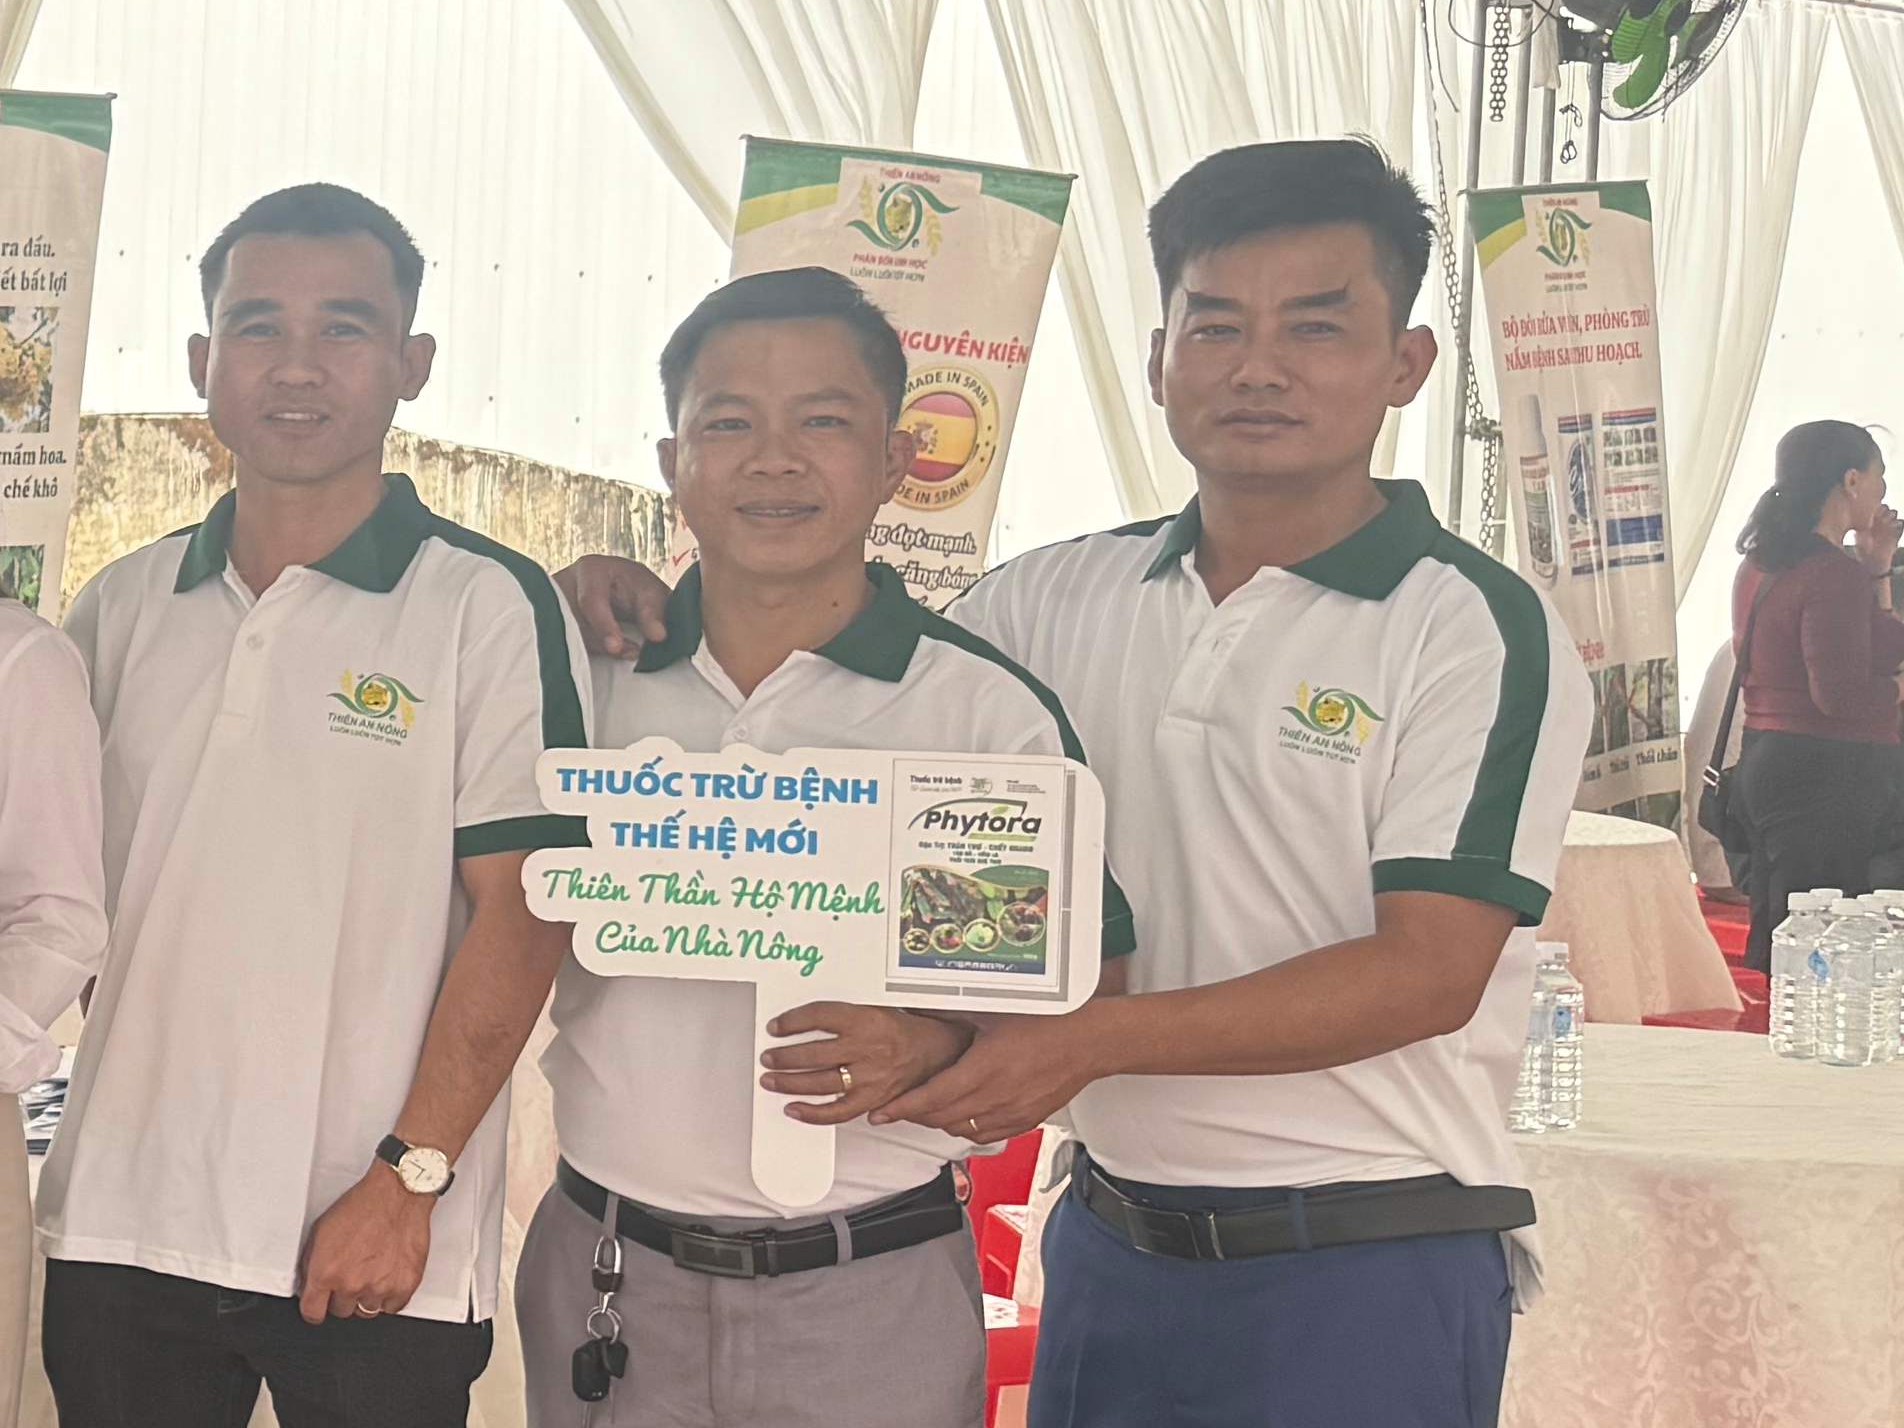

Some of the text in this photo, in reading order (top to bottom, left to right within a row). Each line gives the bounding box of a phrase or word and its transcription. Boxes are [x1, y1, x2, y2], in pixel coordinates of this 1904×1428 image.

[1, 241, 18, 256] ra
[946, 372, 989, 407] IN SPAIN
[39, 445, 67, 465] hoa.
[915, 478, 969, 504] IN SPAIN
[557, 756, 879, 811] THUỐC TRỪ BỆNH
[610, 808, 819, 860] THẾ HỆ MỚI
[923, 810, 1042, 836] Phytora
[542, 868, 885, 921] Thiên Thần Hộ Mệnh
[595, 920, 823, 977] Của Nhà Nông
